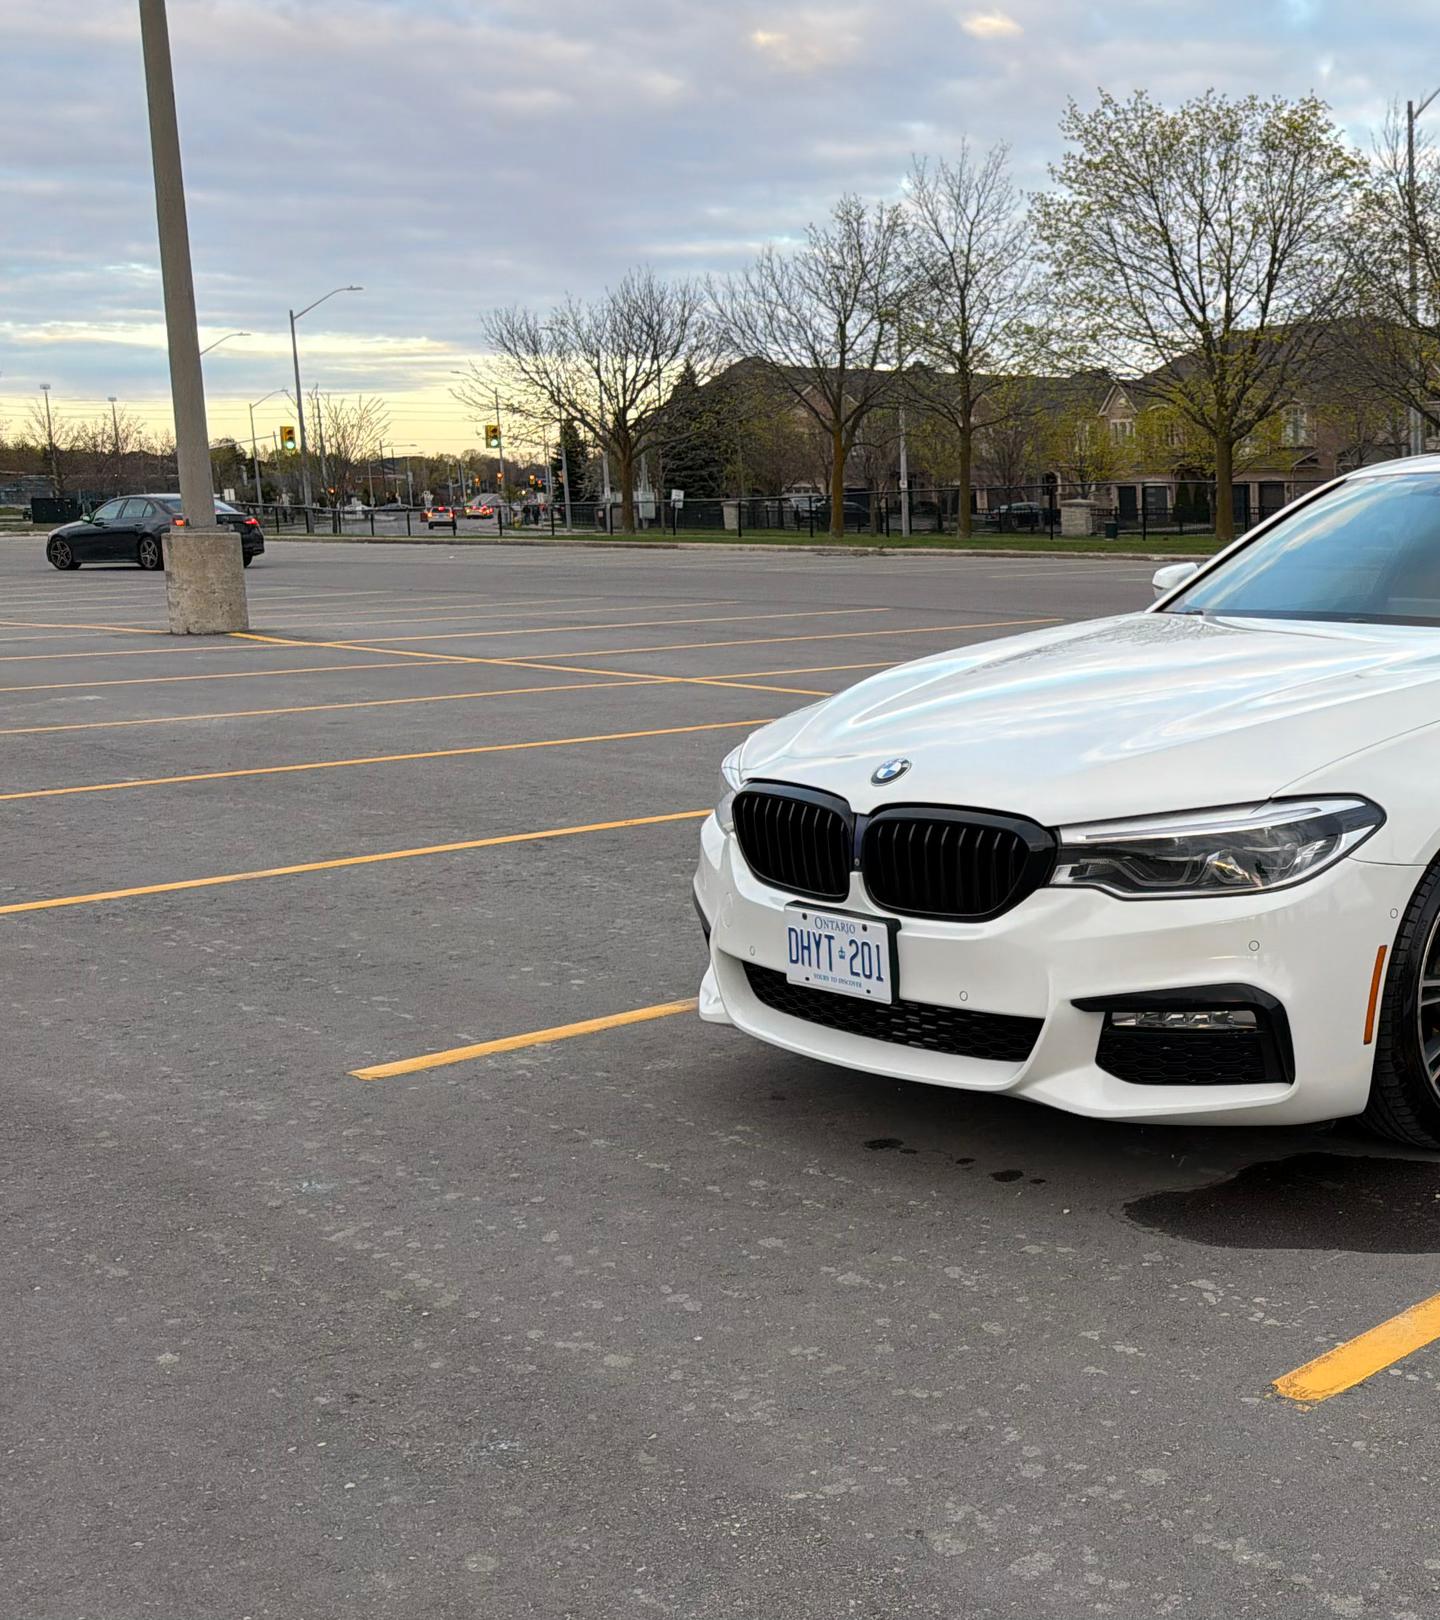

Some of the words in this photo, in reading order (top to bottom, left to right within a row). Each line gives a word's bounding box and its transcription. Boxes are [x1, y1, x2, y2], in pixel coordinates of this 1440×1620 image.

[814, 916, 856, 935] ONTARIO
[787, 927, 835, 972] DHYT
[848, 938, 884, 983] 201
